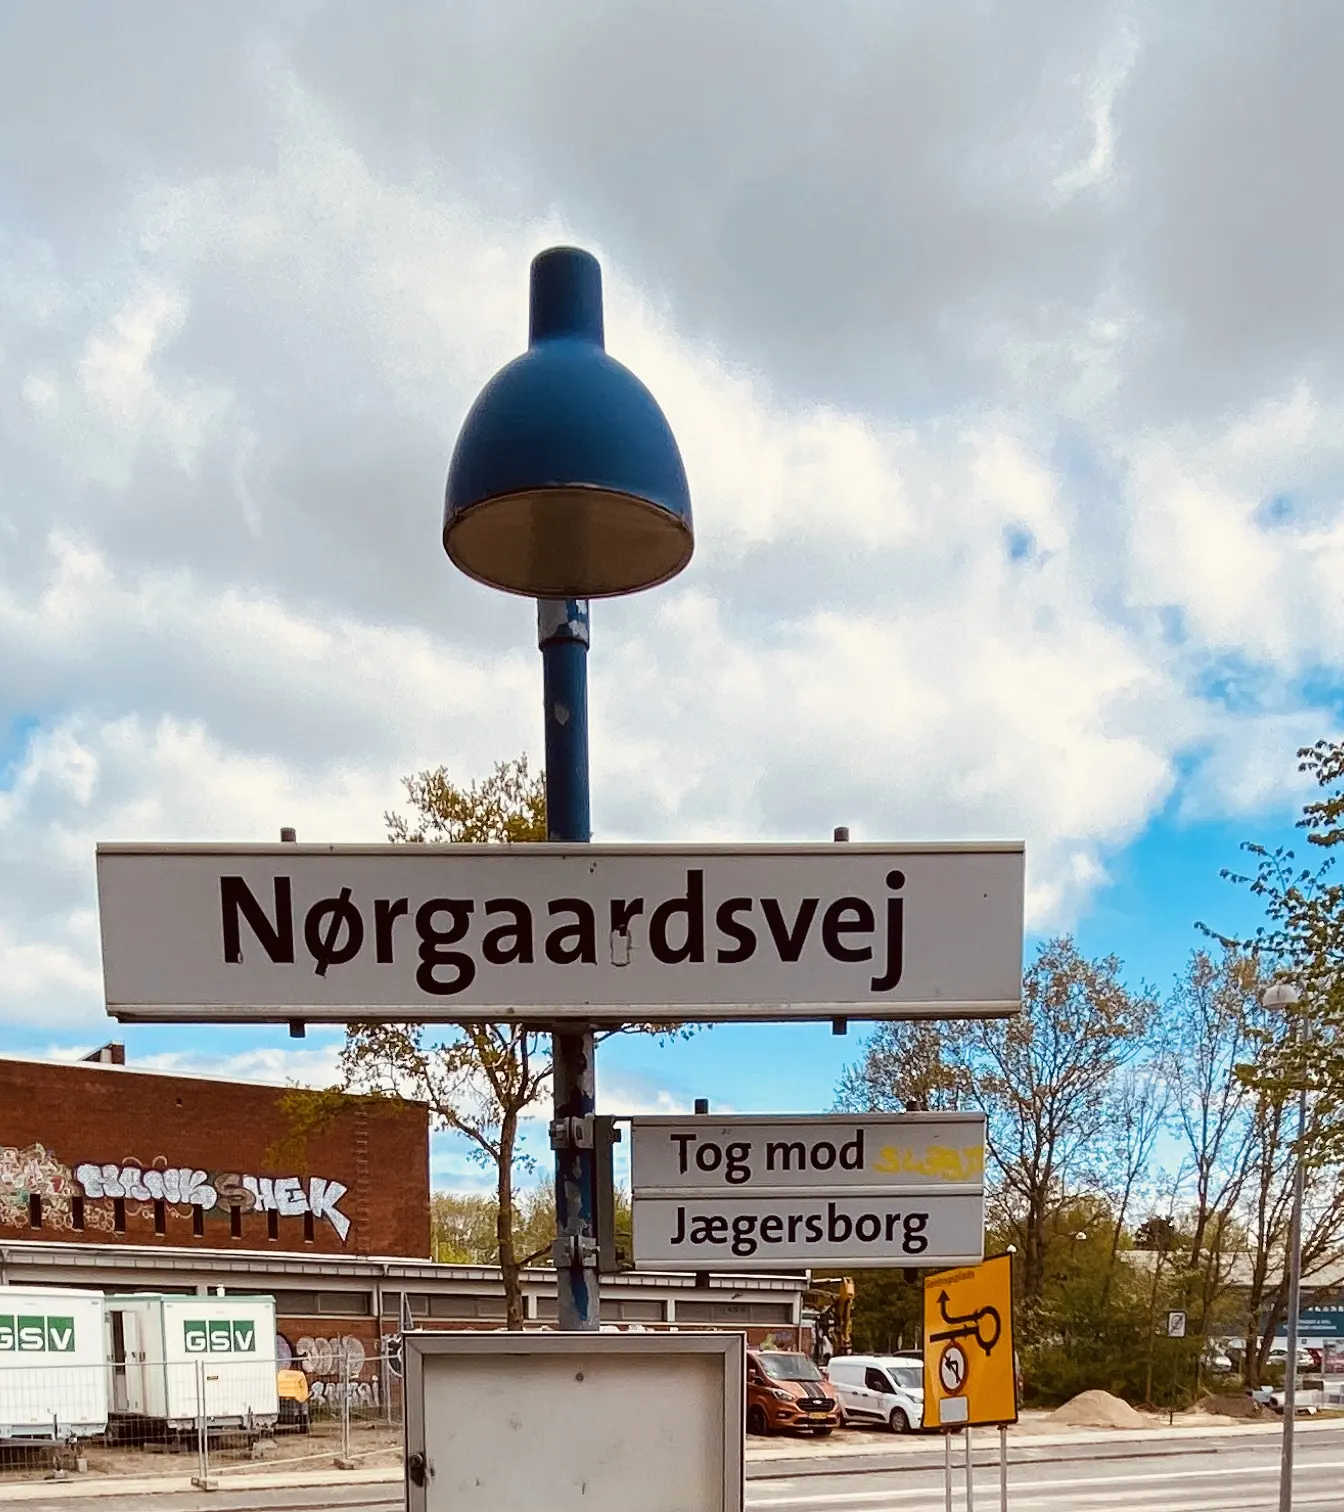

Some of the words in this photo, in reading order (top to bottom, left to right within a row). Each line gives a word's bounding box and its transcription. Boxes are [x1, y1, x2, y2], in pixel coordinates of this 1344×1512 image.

[219, 869, 907, 996] Nørgaardsvej
[670, 1132, 752, 1185] Tog
[766, 1128, 864, 1171] mod
[670, 1201, 930, 1256] Jægersborg
[185, 1329, 254, 1351] GSV
